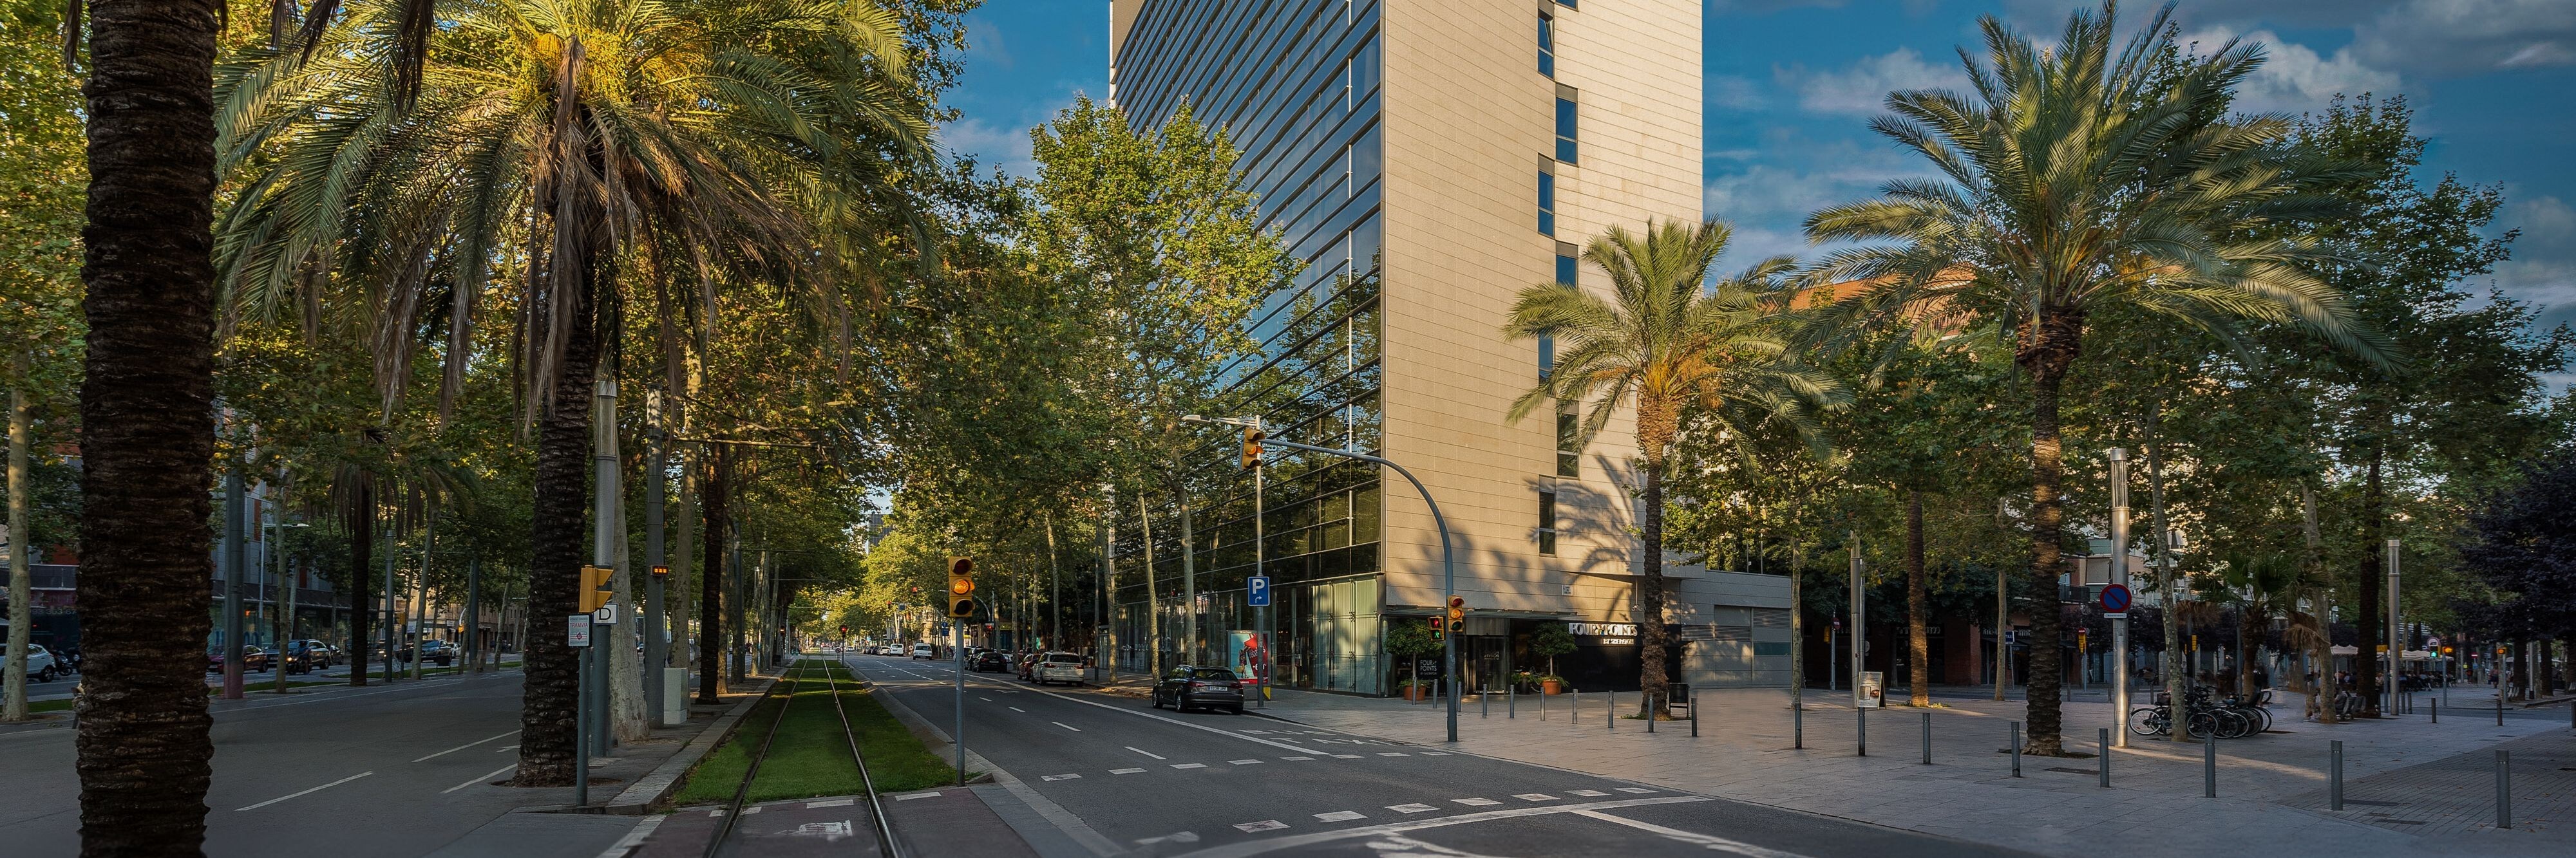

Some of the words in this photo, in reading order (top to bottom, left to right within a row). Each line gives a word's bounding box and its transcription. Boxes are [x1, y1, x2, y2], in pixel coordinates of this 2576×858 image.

[1253, 579, 1265, 594] P
[599, 608, 611, 620] D
[1569, 623, 1598, 635] FOUR
[1602, 624, 1638, 637] POINTS
[1269, 738, 1397, 746] TAXI
